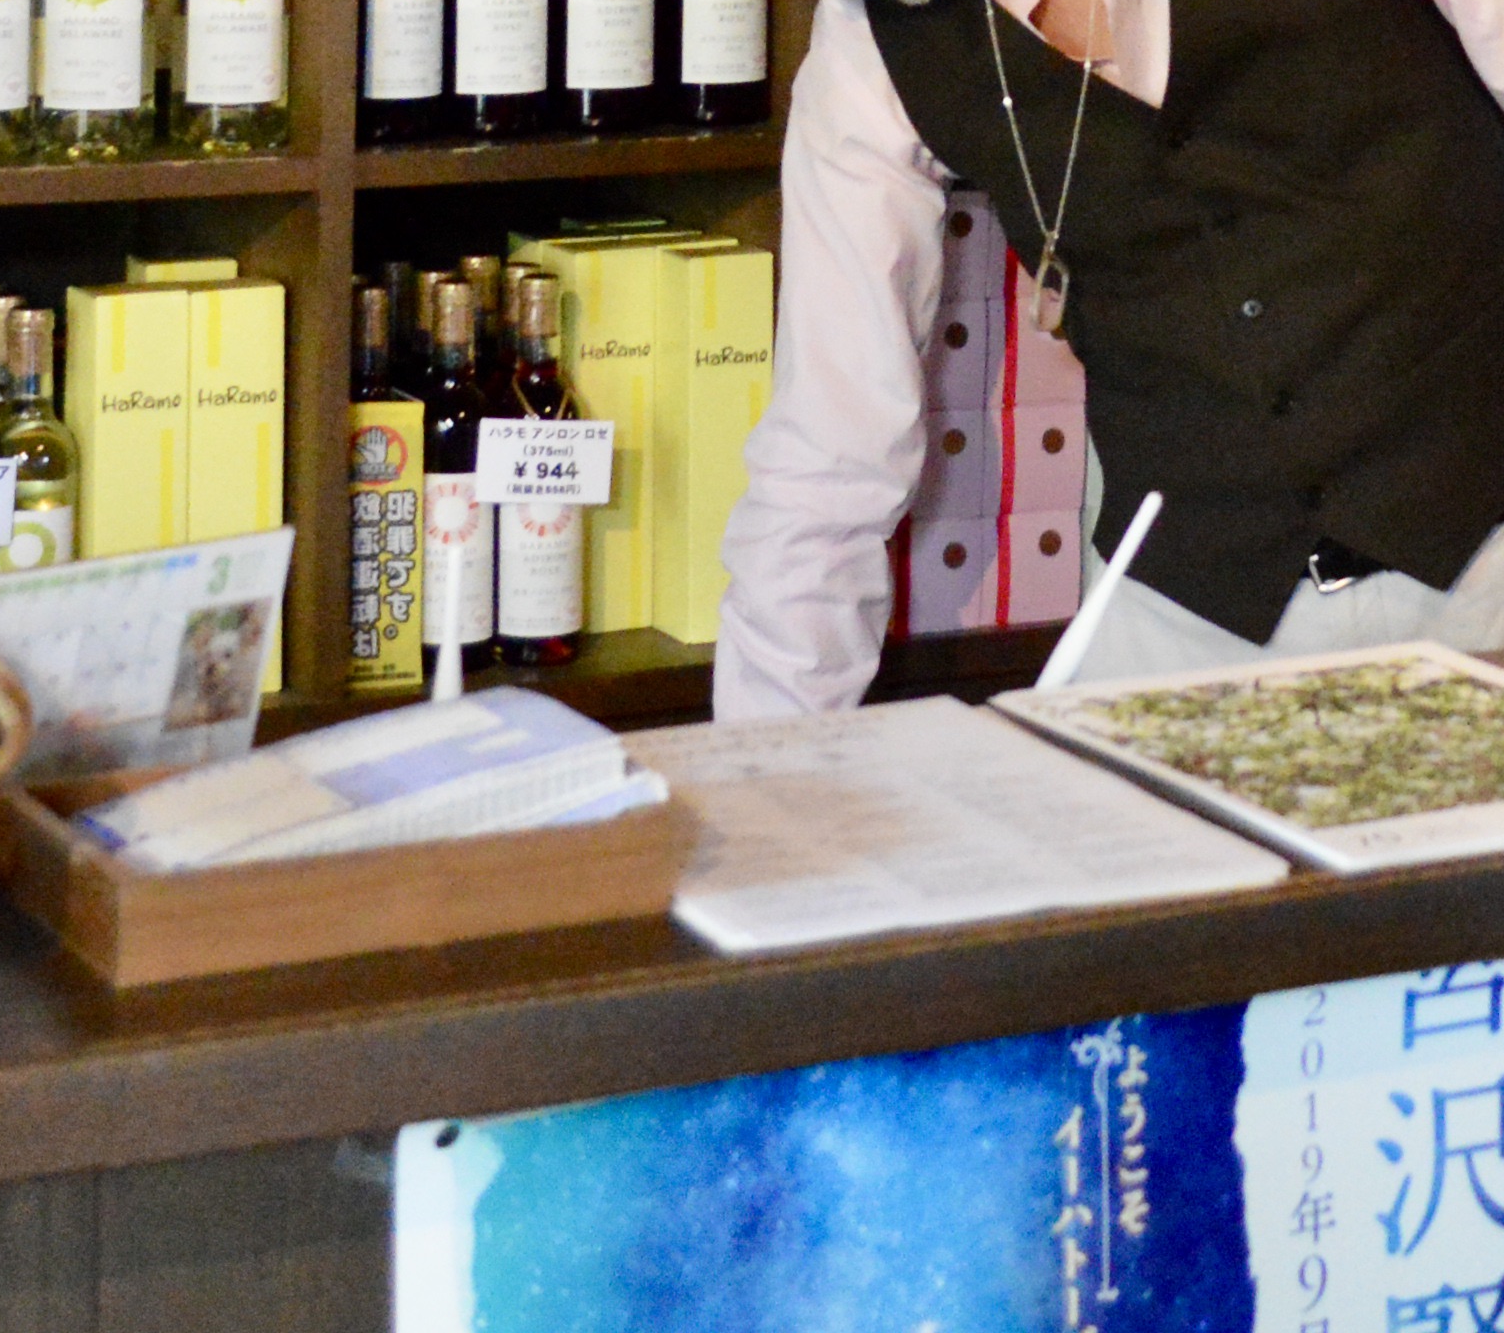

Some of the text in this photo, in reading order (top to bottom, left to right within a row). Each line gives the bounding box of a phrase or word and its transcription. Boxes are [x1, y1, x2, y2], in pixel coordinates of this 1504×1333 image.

[581, 341, 652, 361] HaRamo
[696, 347, 768, 368] HaRamo
[101, 391, 182, 413] HaRamo
[197, 386, 279, 408] HaRamo
[489, 427, 526, 440] ハラモ
[536, 461, 579, 480] 944
[1117, 1043, 1151, 1237] ようこそ
